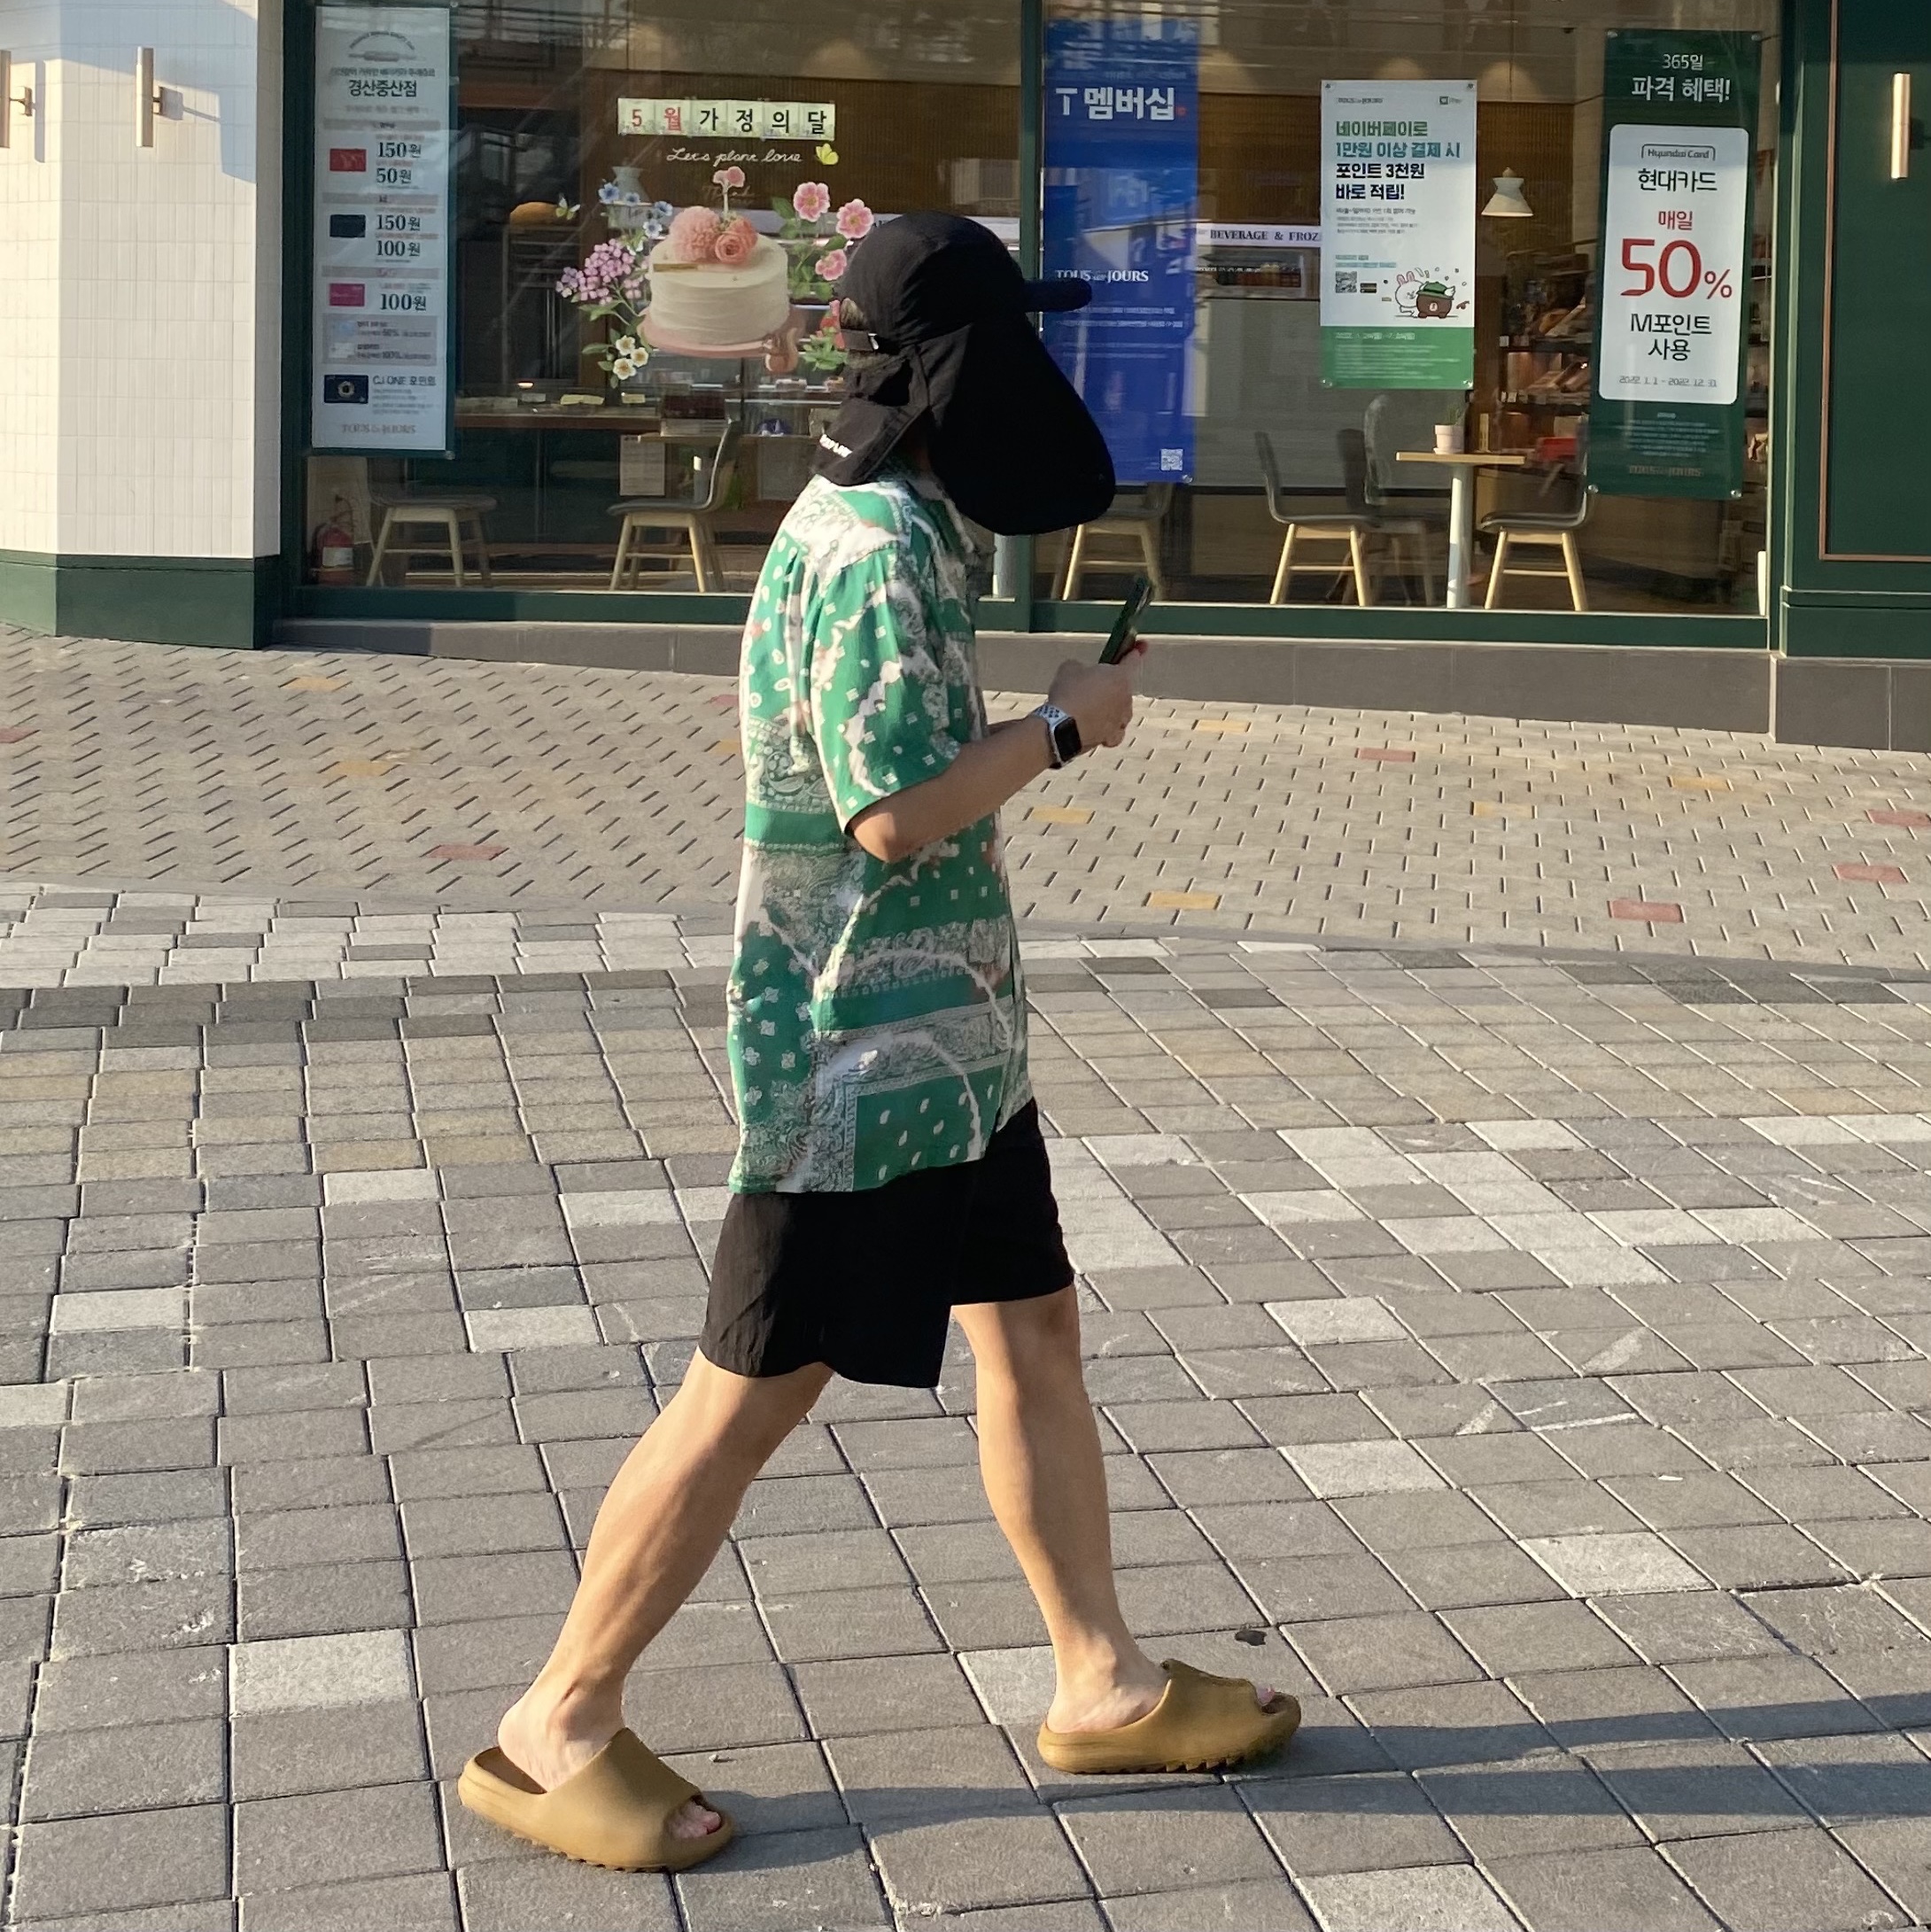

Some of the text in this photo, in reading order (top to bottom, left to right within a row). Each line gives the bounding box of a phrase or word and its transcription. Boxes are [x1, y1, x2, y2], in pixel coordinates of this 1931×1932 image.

[1662, 53, 1703, 71] 365일
[348, 80, 417, 97] 경산중산점
[1631, 75, 1731, 103] 파격 혜택!
[1055, 86, 1175, 120] T 멤버십
[1336, 120, 1428, 136] 네이버페이로
[761, 148, 803, 163] love
[1336, 142, 1461, 159] 1만원 이상 결제 시
[1336, 162, 1425, 179] 포인트 3천원
[1638, 167, 1718, 193] 현대카드
[1336, 183, 1405, 200] 바로 적립!
[1657, 210, 1693, 230] 매일
[1210, 229, 1322, 242] BEVERAGE & FROZ
[1107, 269, 1150, 283] JOURS
[1620, 237, 1733, 300] 50%
[1630, 313, 1712, 336] M포인트
[1648, 338, 1691, 361] 사용
